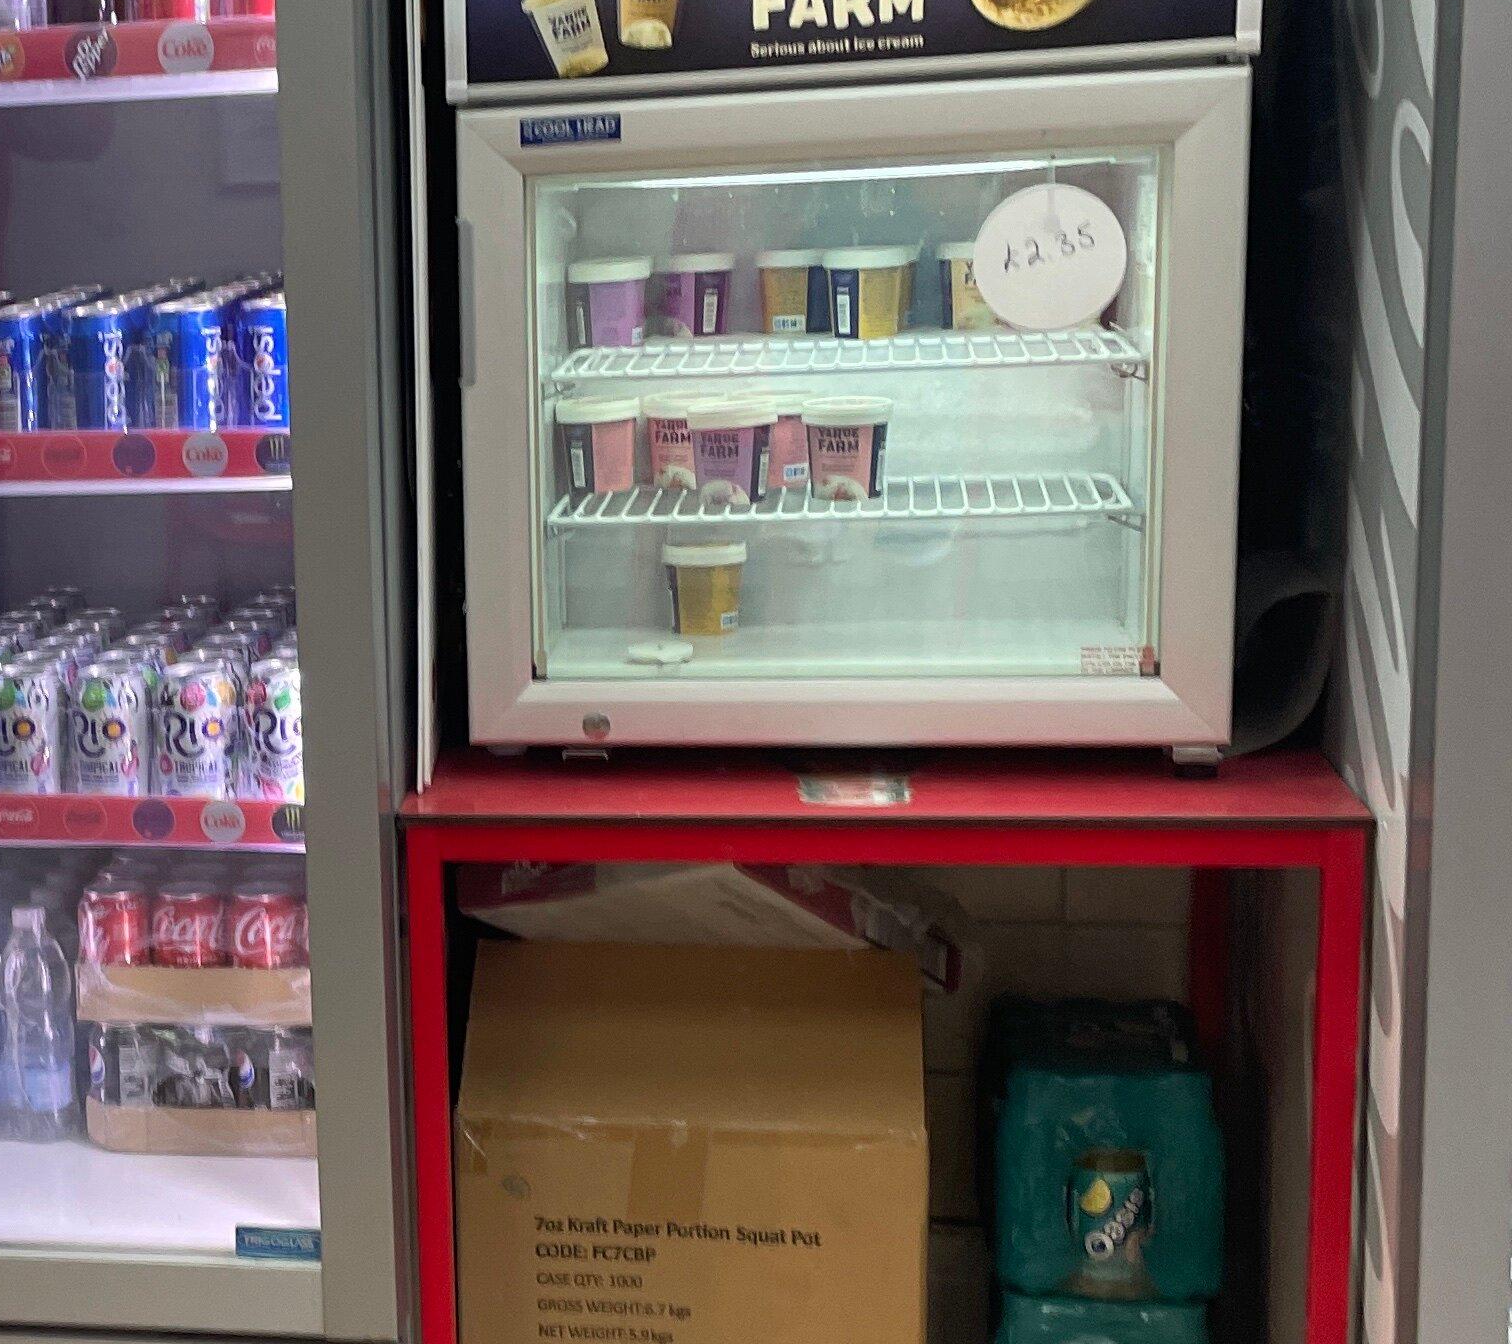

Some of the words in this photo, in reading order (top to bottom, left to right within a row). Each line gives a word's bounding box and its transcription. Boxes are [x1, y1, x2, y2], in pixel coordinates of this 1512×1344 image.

[750, 40, 806, 58] Serious
[808, 37, 850, 55] about
[878, 33, 925, 51] cream
[249, 325, 282, 421] pepsi
[818, 438, 859, 453] FARM
[534, 1216, 564, 1233] 7oz
[568, 1216, 608, 1234] Kraft
[613, 1218, 659, 1238] Paper
[667, 1221, 730, 1241] Portion
[736, 1226, 787, 1247] Squat
[791, 1228, 822, 1248] Pot
[535, 1243, 588, 1258] CODE:
[536, 1272, 569, 1285] CASE
[608, 1274, 643, 1289] 1000
[537, 1298, 583, 1312] GROSS
[539, 1323, 565, 1338] NET
